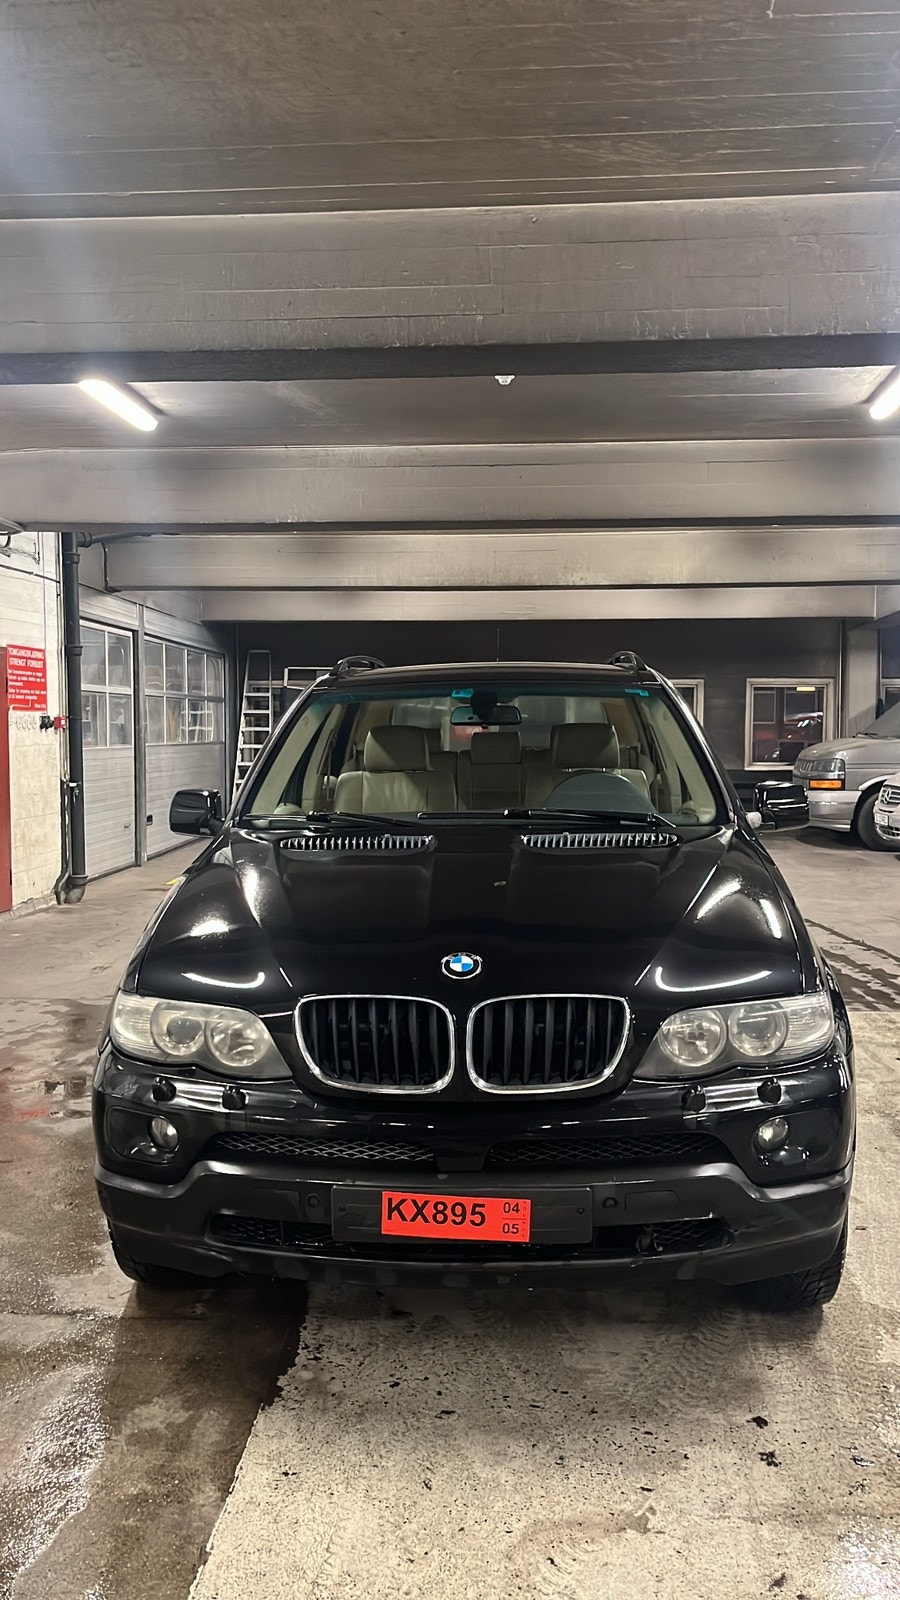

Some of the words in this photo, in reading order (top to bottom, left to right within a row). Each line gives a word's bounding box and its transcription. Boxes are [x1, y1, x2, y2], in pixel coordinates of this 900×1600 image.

[387, 1197, 486, 1227] KX895
[503, 1202, 520, 1214] 04
[502, 1223, 519, 1235] 05
